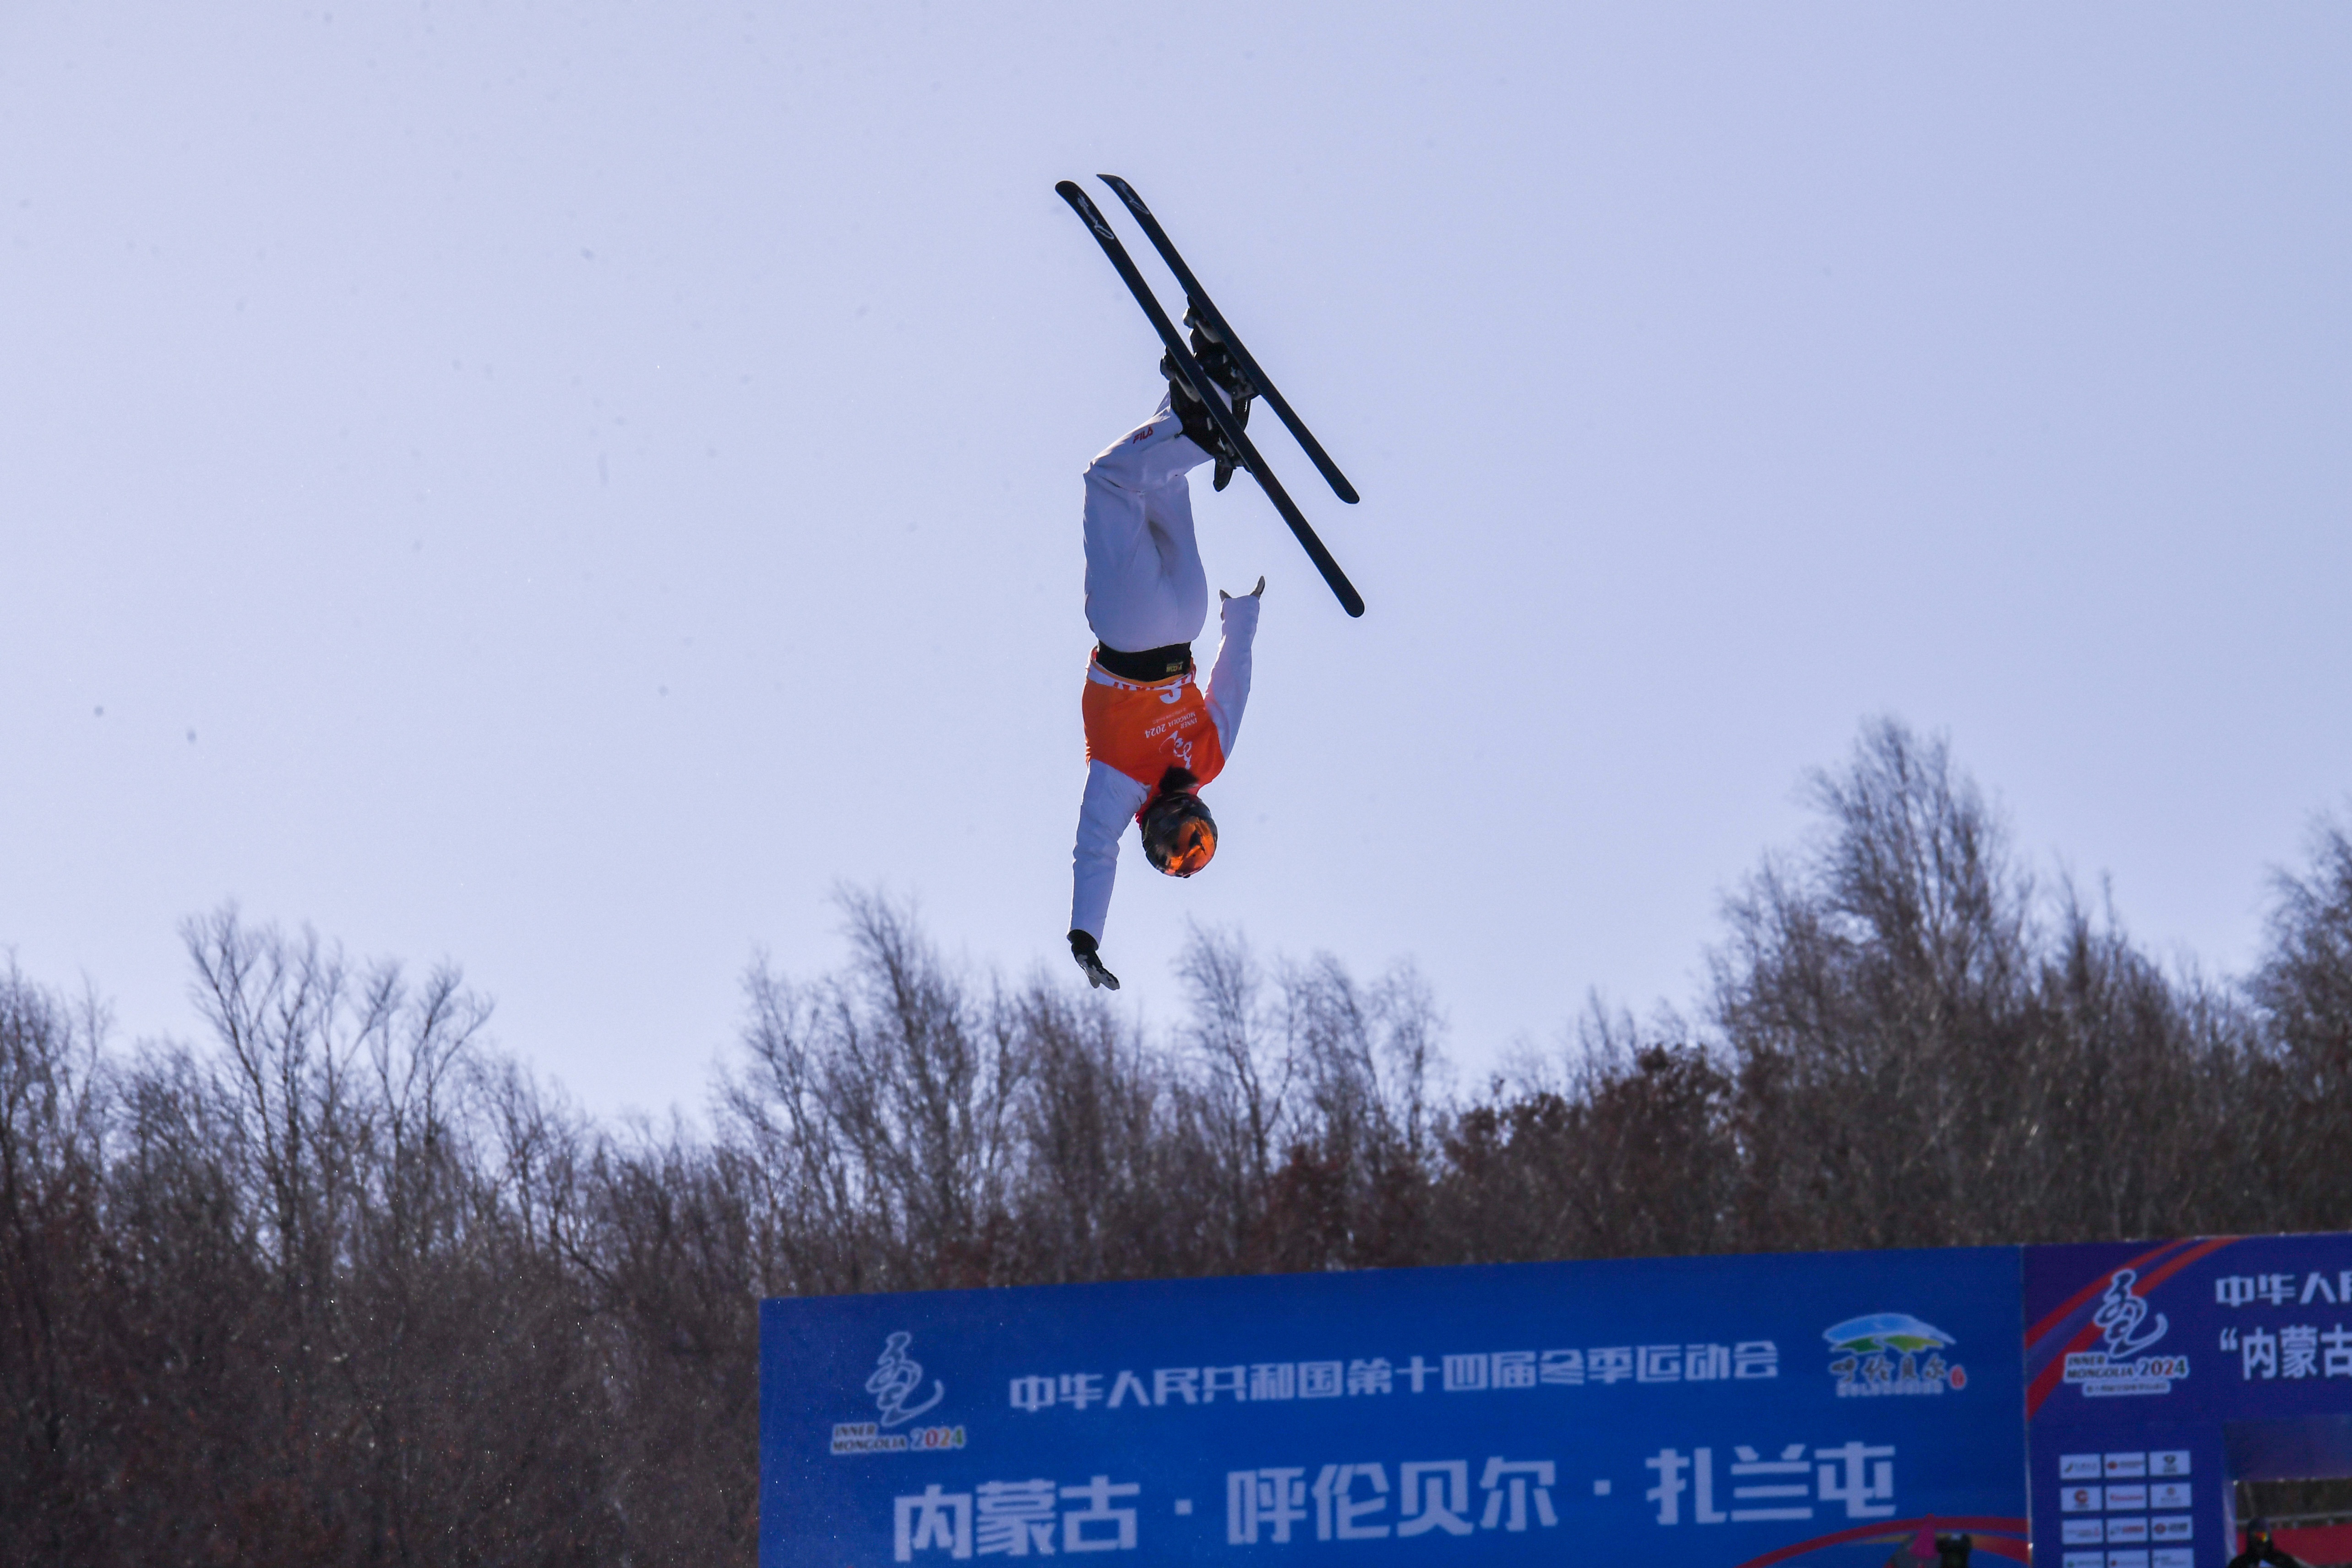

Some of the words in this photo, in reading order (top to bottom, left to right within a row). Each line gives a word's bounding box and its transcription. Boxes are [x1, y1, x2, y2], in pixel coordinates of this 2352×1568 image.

[1133, 426, 1153, 444] FILA
[1168, 712, 1196, 727] MONGOLIA
[1181, 718, 1197, 729] INNER
[1145, 724, 1166, 738] 2024
[1010, 1340, 1778, 1412] 中华人民共和国第十四届冬季运动会
[2138, 1358, 2186, 1377] 2024
[910, 1427, 964, 1450] 2024
